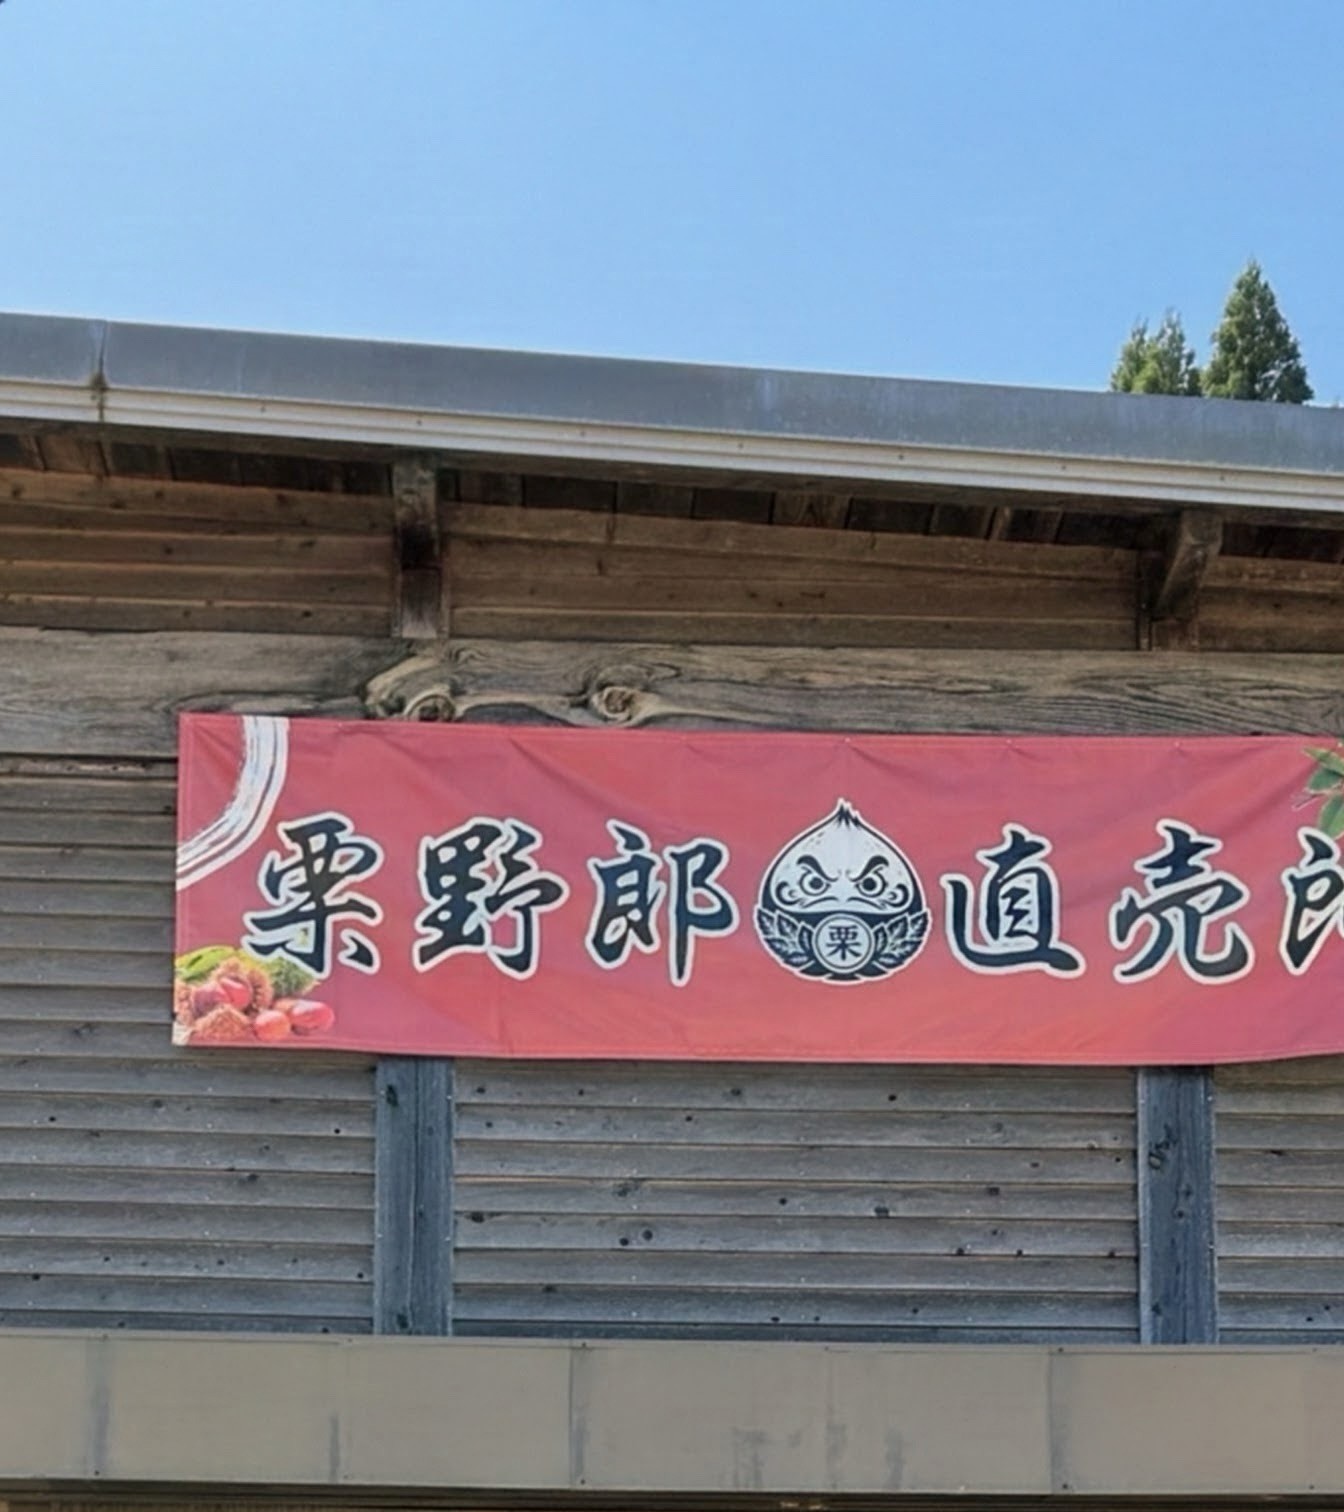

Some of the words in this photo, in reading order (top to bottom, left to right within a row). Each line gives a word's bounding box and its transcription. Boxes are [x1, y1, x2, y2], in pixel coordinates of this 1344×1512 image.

[242, 812, 740, 988] 栗野郎
[827, 925, 860, 960] 栗
